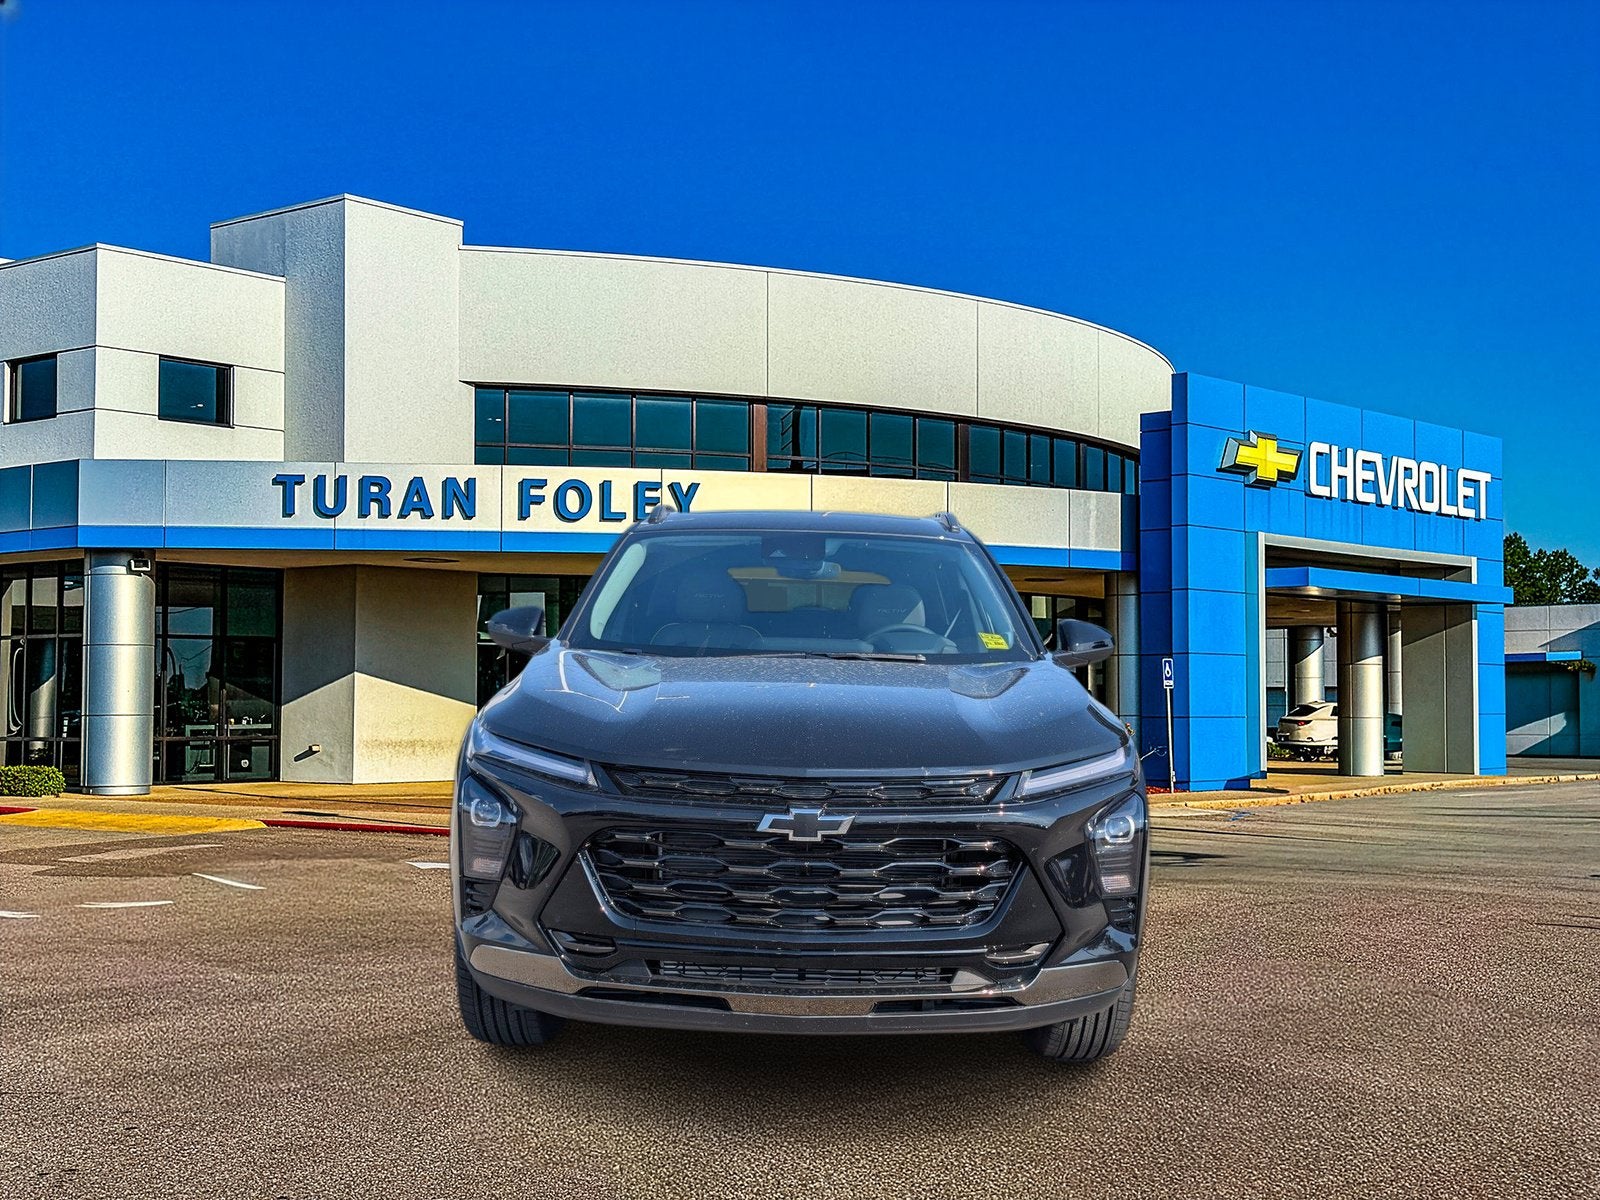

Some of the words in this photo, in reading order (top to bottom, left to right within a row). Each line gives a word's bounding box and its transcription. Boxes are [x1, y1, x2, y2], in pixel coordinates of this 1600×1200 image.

[272, 474, 476, 520] TURAN
[517, 478, 700, 522] FOLEY
[1307, 440, 1492, 520] CHEVROLET
